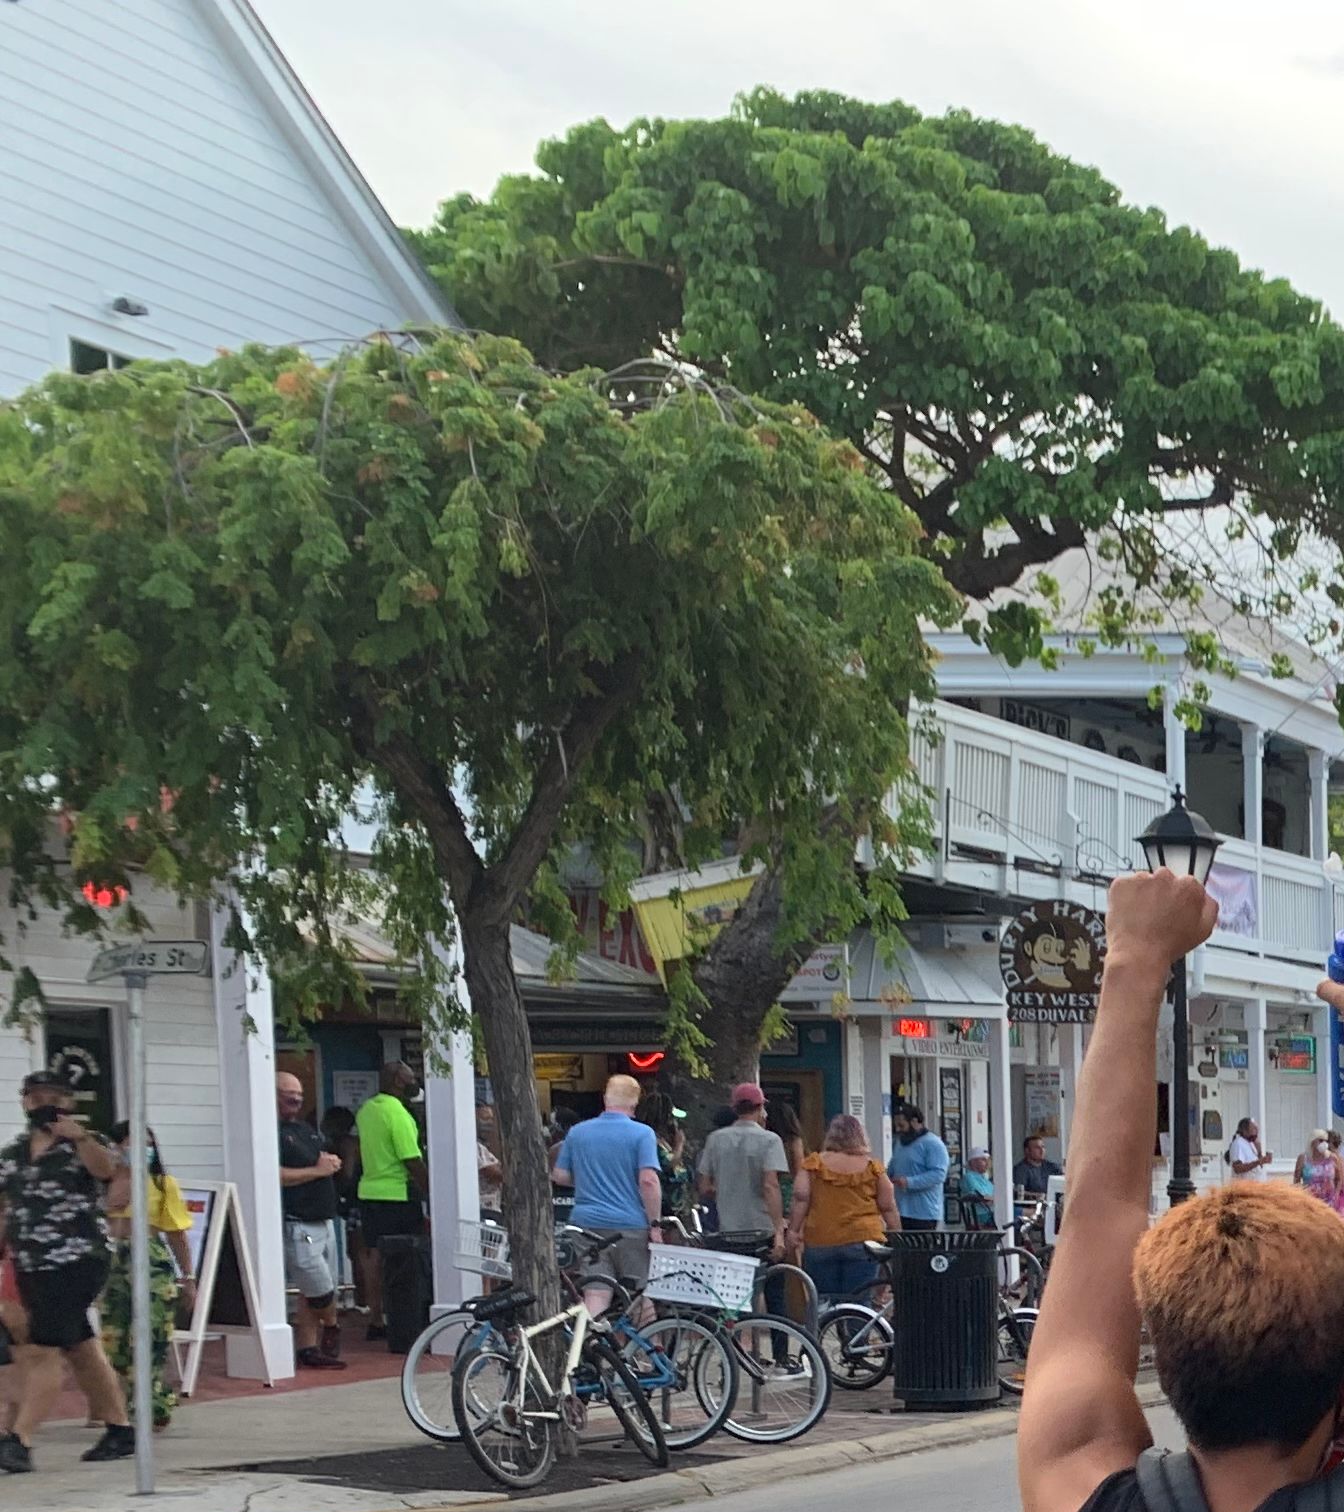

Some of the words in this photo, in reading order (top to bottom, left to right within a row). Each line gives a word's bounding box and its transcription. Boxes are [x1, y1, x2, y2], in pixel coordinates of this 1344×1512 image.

[1011, 992, 1048, 1006] KEY
[1011, 1008, 1036, 1021] 208
[1037, 1008, 1087, 1022] DUVAL
